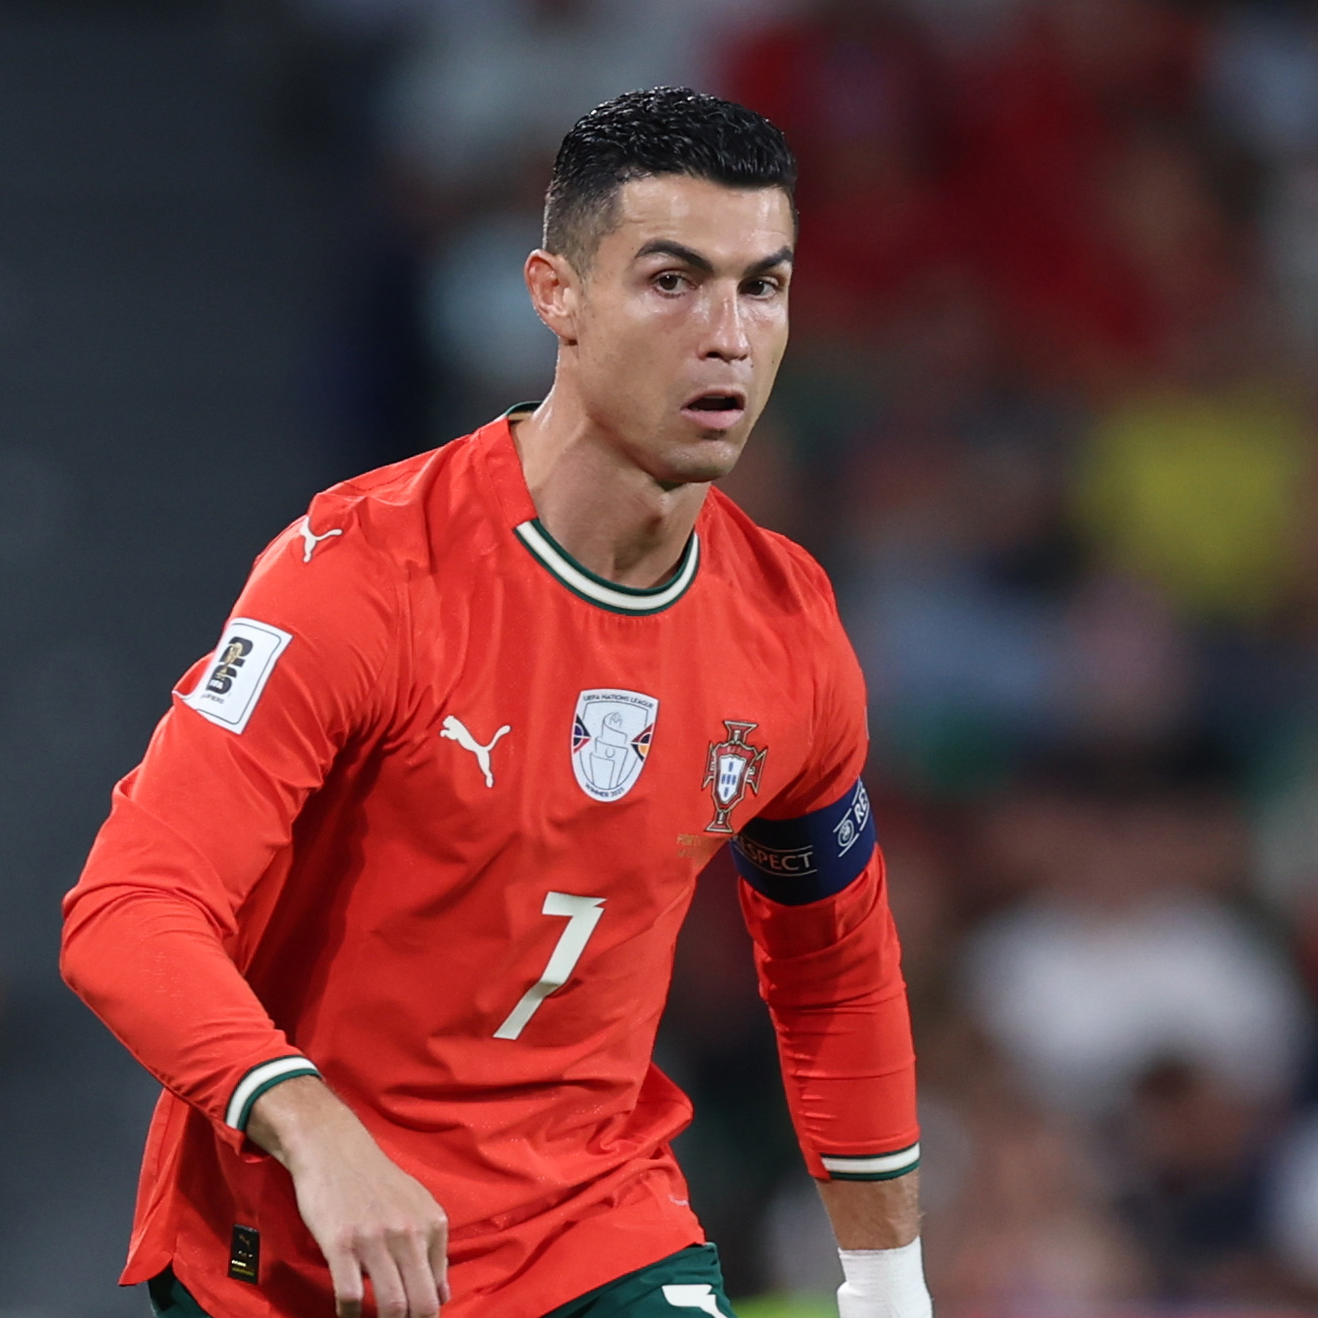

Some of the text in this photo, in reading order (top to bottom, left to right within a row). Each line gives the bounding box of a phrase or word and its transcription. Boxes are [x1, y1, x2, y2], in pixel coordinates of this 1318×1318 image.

[602, 694, 630, 702] NATIONS
[631, 696, 654, 709] LEAGUE
[493, 891, 608, 1040] 7
